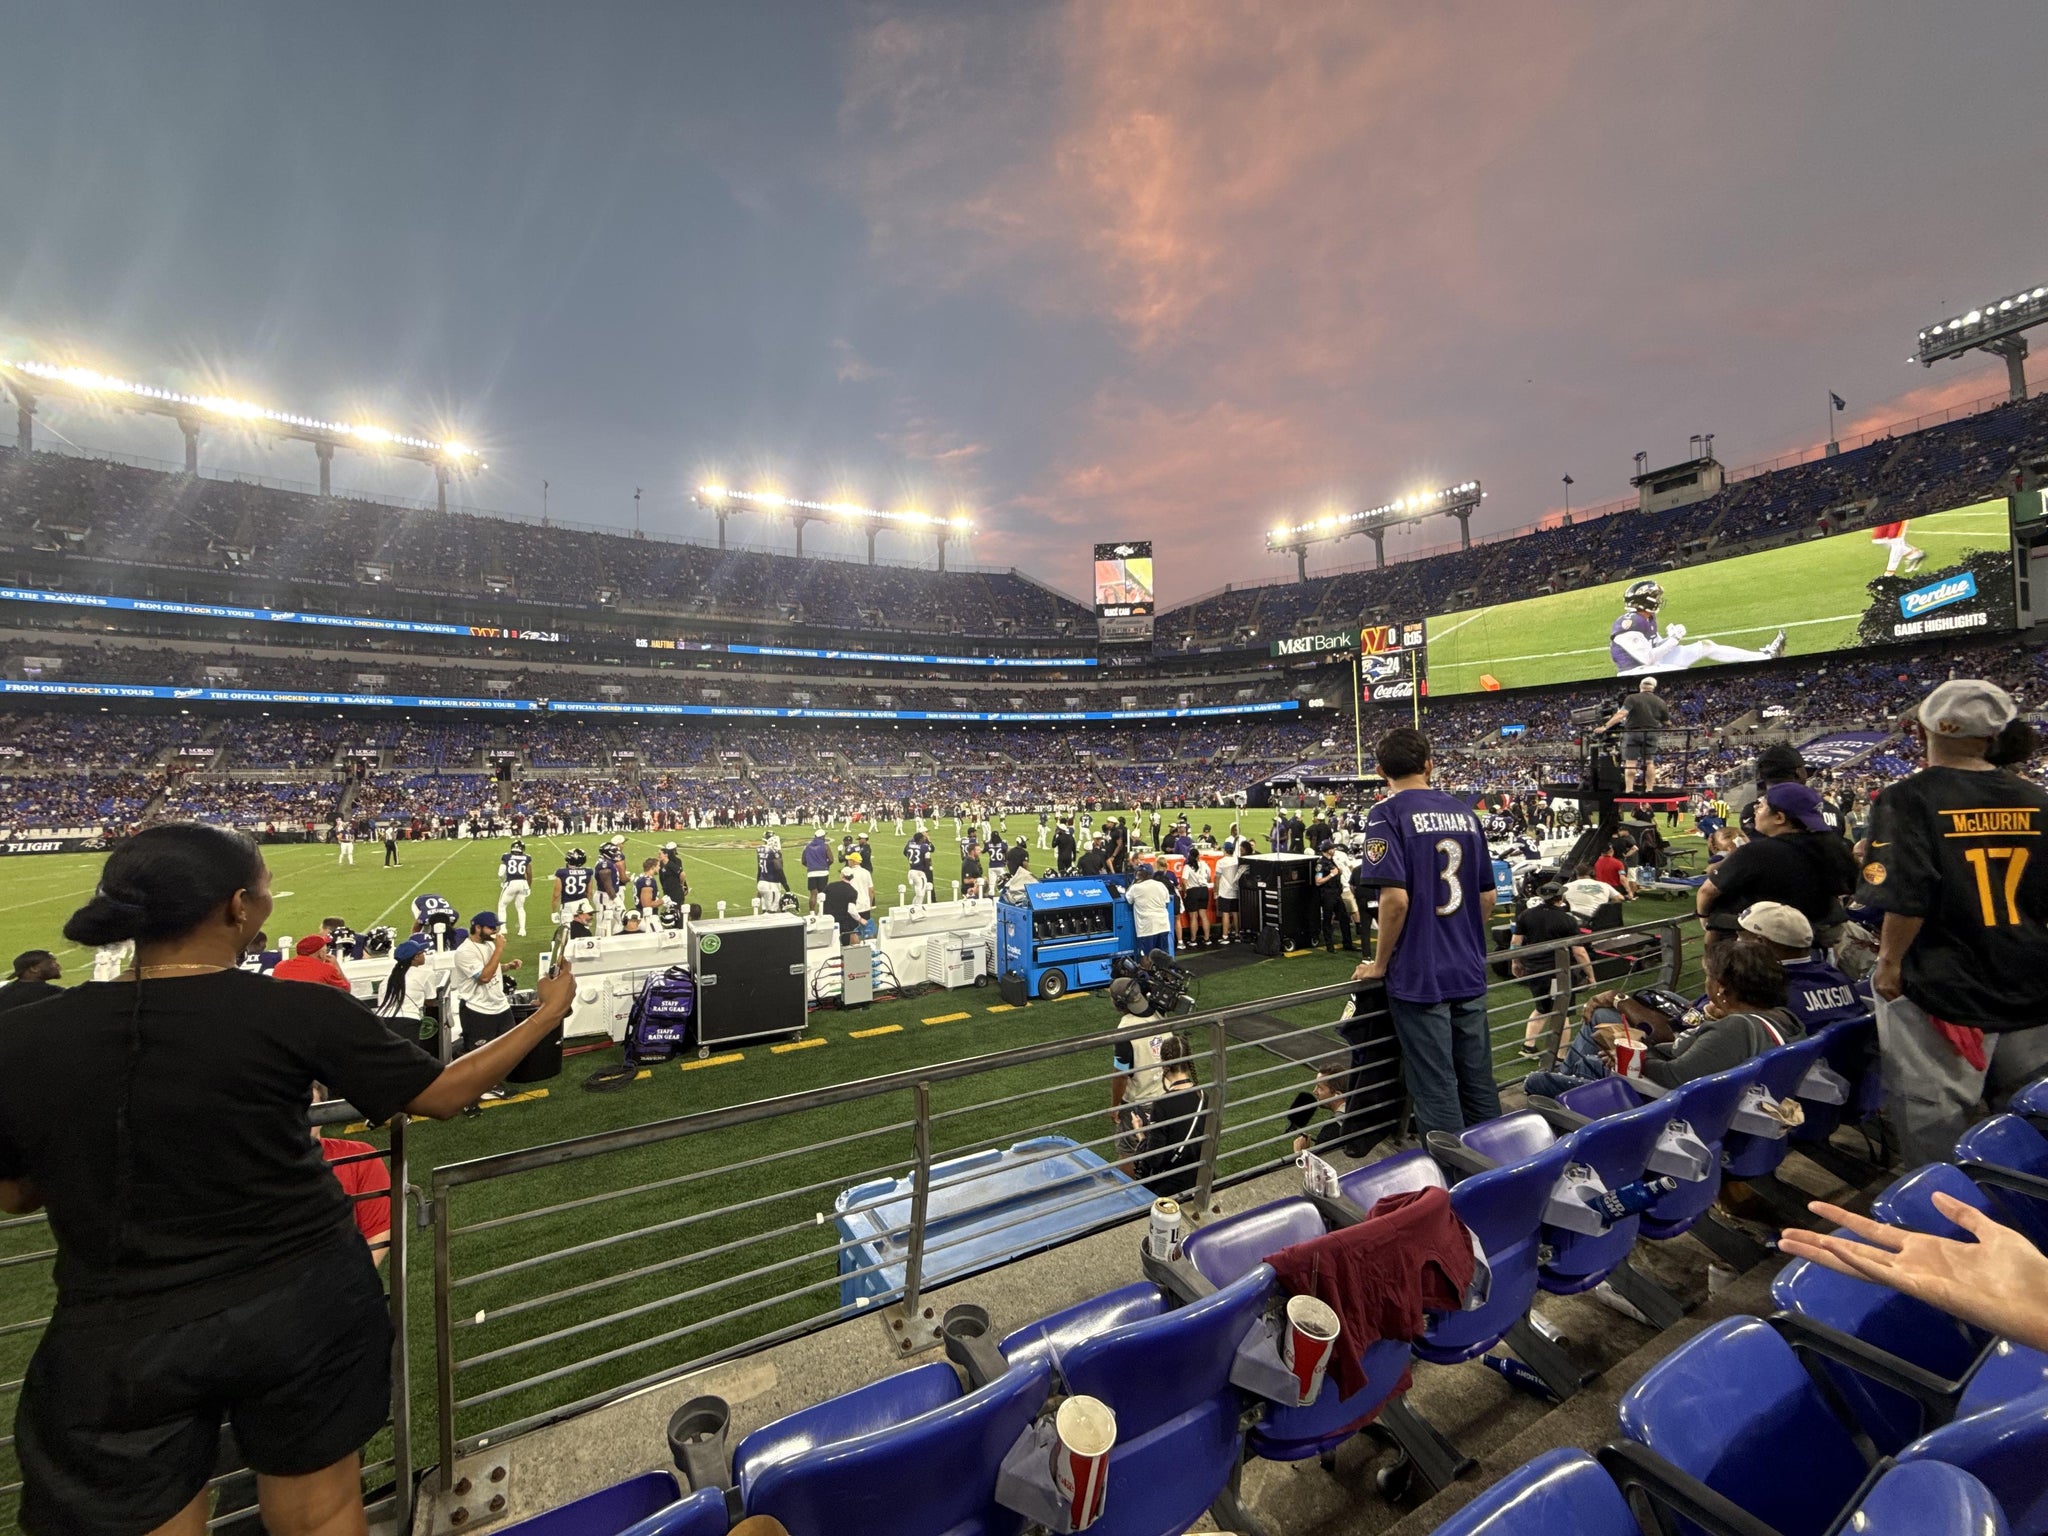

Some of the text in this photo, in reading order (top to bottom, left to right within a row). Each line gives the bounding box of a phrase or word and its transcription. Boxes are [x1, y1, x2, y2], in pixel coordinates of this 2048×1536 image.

[19, 592, 38, 600] THE
[43, 594, 107, 605] RAVENS
[1904, 580, 1970, 611] Perdue
[134, 602, 161, 610] FROM
[163, 603, 183, 611] OUR
[184, 604, 211, 615] FLOCK
[227, 609, 255, 618] YOURS
[318, 617, 353, 626] OFFICIAL
[354, 620, 384, 628] CHICKEN
[412, 624, 457, 633] RAVENS
[1894, 612, 1988, 637] GAME HIGHLIGHTS
[550, 632, 559, 642] 24
[1278, 632, 1351, 656] M&T Bank
[1388, 629, 1396, 644] 0
[1403, 631, 1423, 646] 0:05
[1386, 657, 1400, 674] 24
[6, 684, 38, 692] FROM
[41, 685, 66, 693] OUR
[120, 688, 154, 696] YOURS
[173, 688, 203, 698] Perdue
[342, 697, 393, 705] RAVENS
[1412, 812, 1467, 834] BECKHAM
[1492, 820, 1506, 831] 99
[1952, 812, 2031, 833] McLAURIN
[8, 842, 63, 852] FLIGHT
[988, 848, 1003, 860] 26
[908, 848, 921, 864] 23
[507, 859, 526, 875] 86
[1435, 838, 1463, 916] 3
[565, 876, 587, 895] 85
[1965, 847, 2029, 926] 17
[1803, 985, 1855, 1012] JACKSON
[1516, 1369, 1538, 1384] LIGHT
